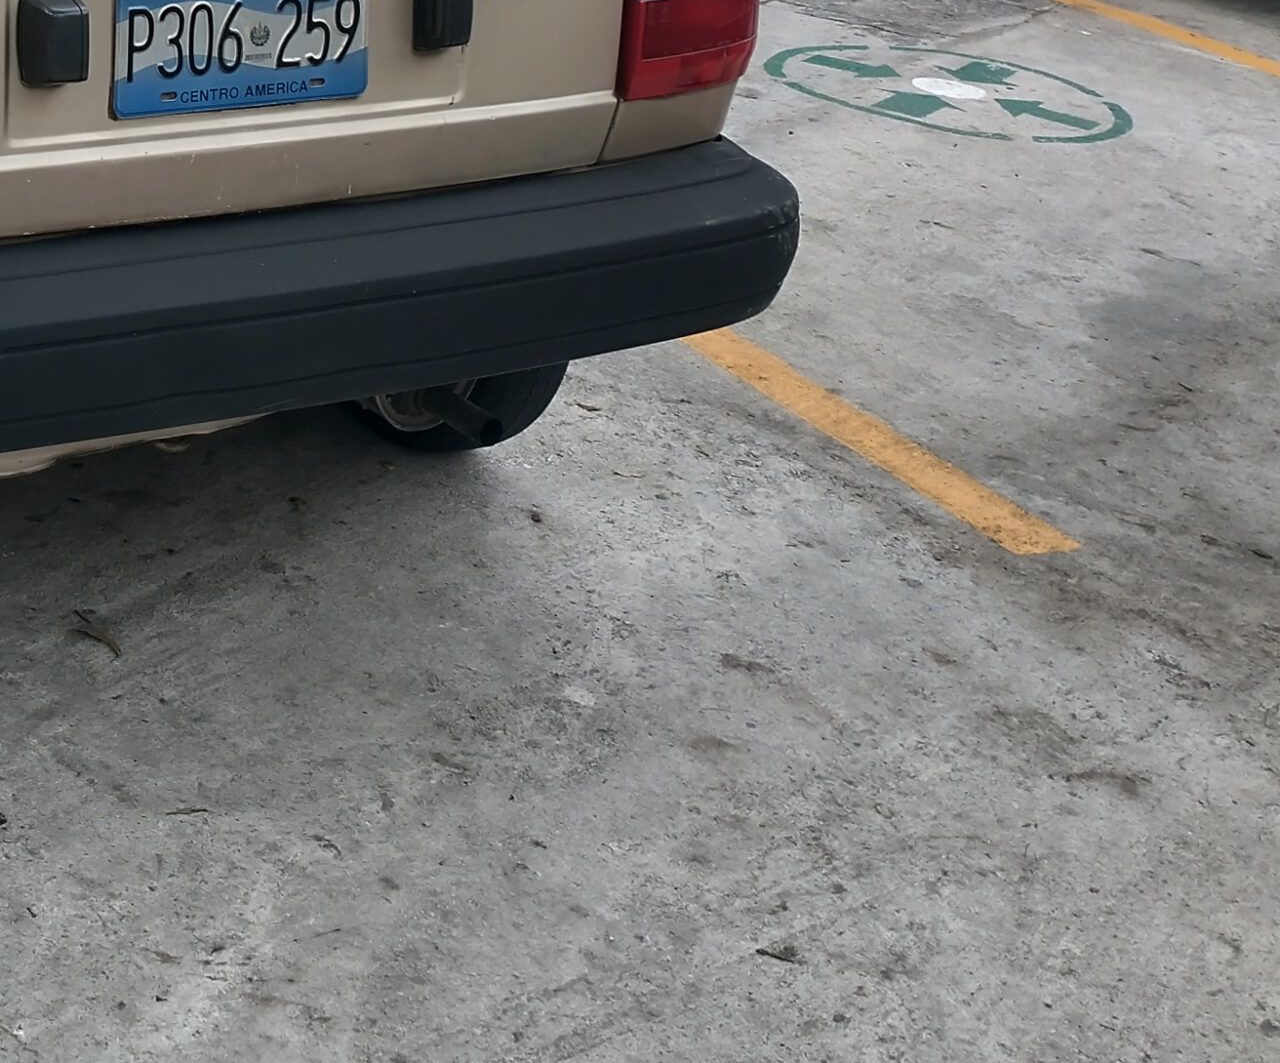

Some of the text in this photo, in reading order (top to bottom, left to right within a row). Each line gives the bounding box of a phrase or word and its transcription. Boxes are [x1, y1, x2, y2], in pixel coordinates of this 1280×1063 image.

[125, 0, 244, 84] P306
[180, 80, 309, 104] CENTRO AMERICA
